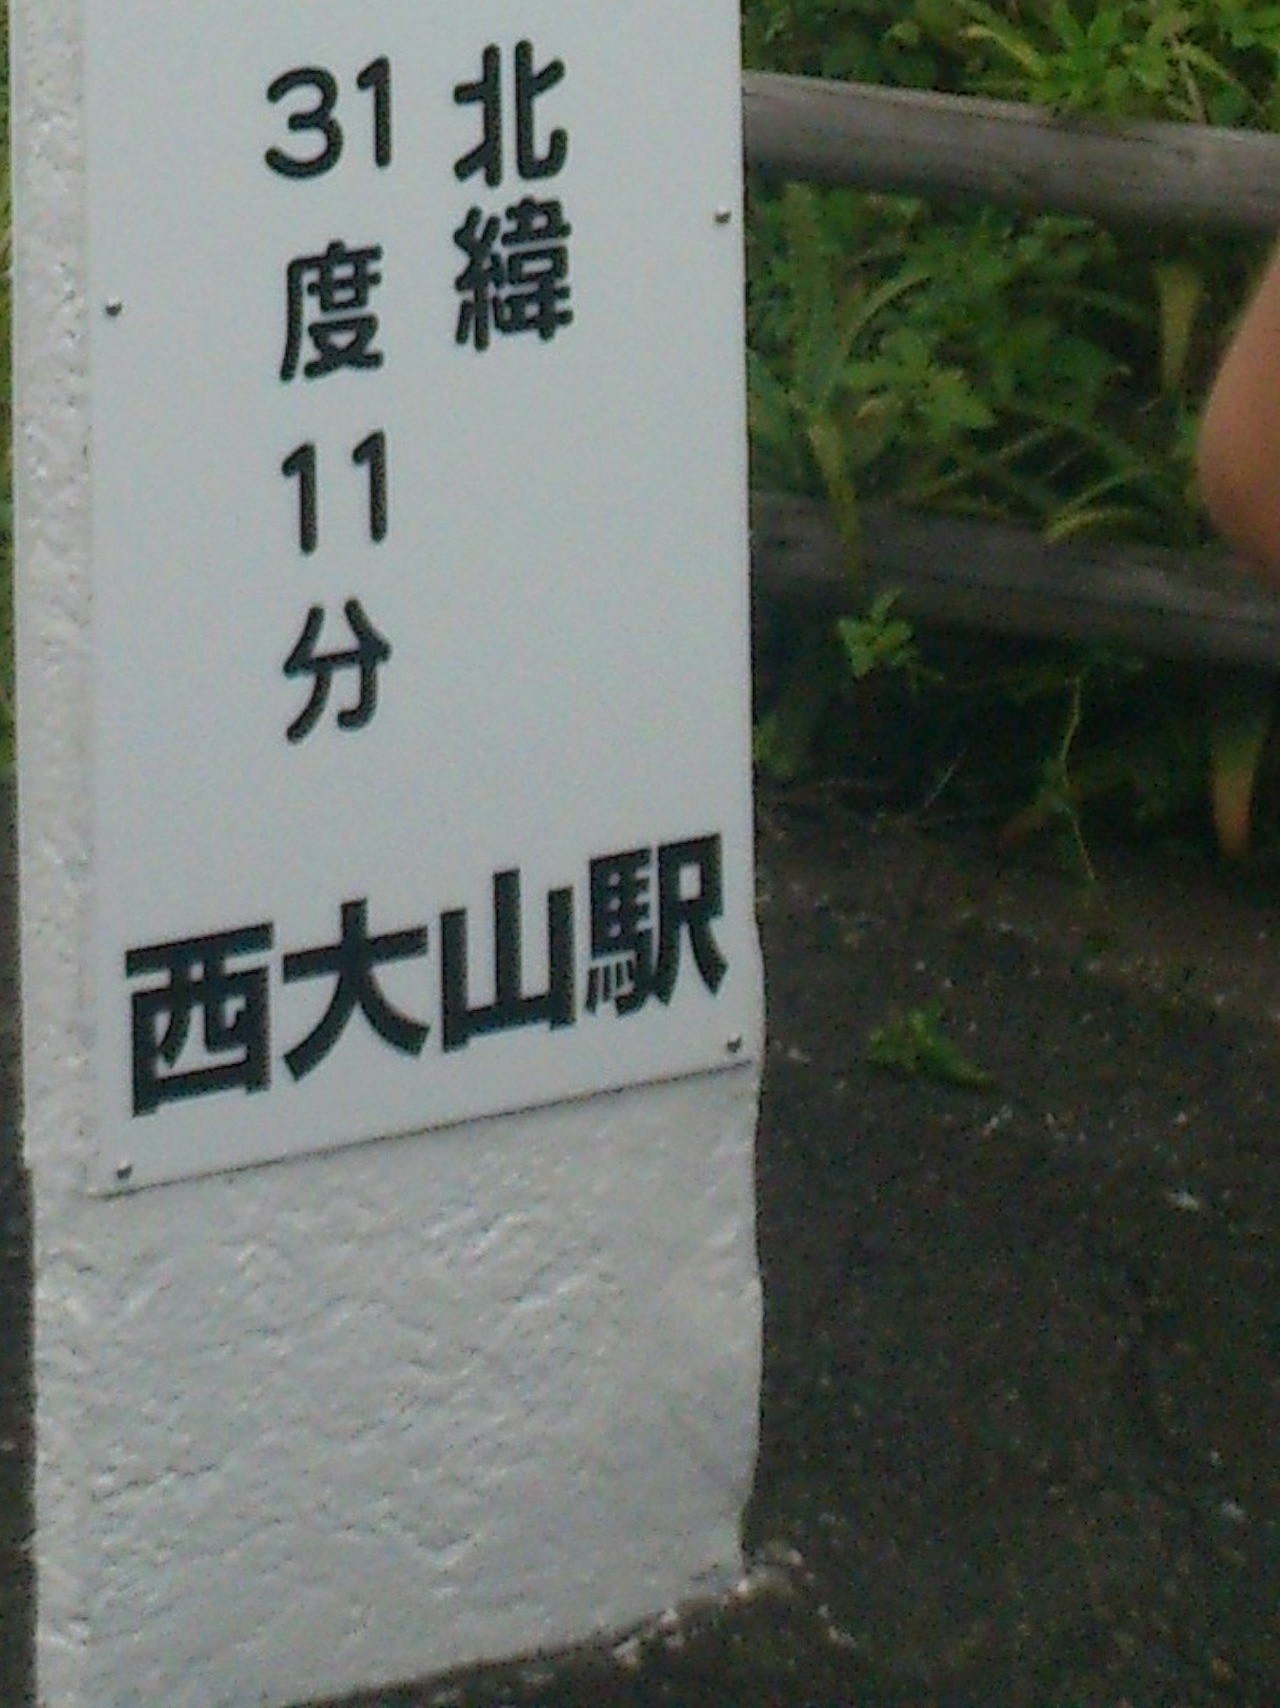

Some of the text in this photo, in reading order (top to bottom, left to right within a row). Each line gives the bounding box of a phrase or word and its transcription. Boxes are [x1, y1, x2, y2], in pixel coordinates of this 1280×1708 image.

[452, 40, 575, 354] 北緯
[263, 54, 394, 745] 31度11分
[124, 834, 728, 1119] 西大山駅
